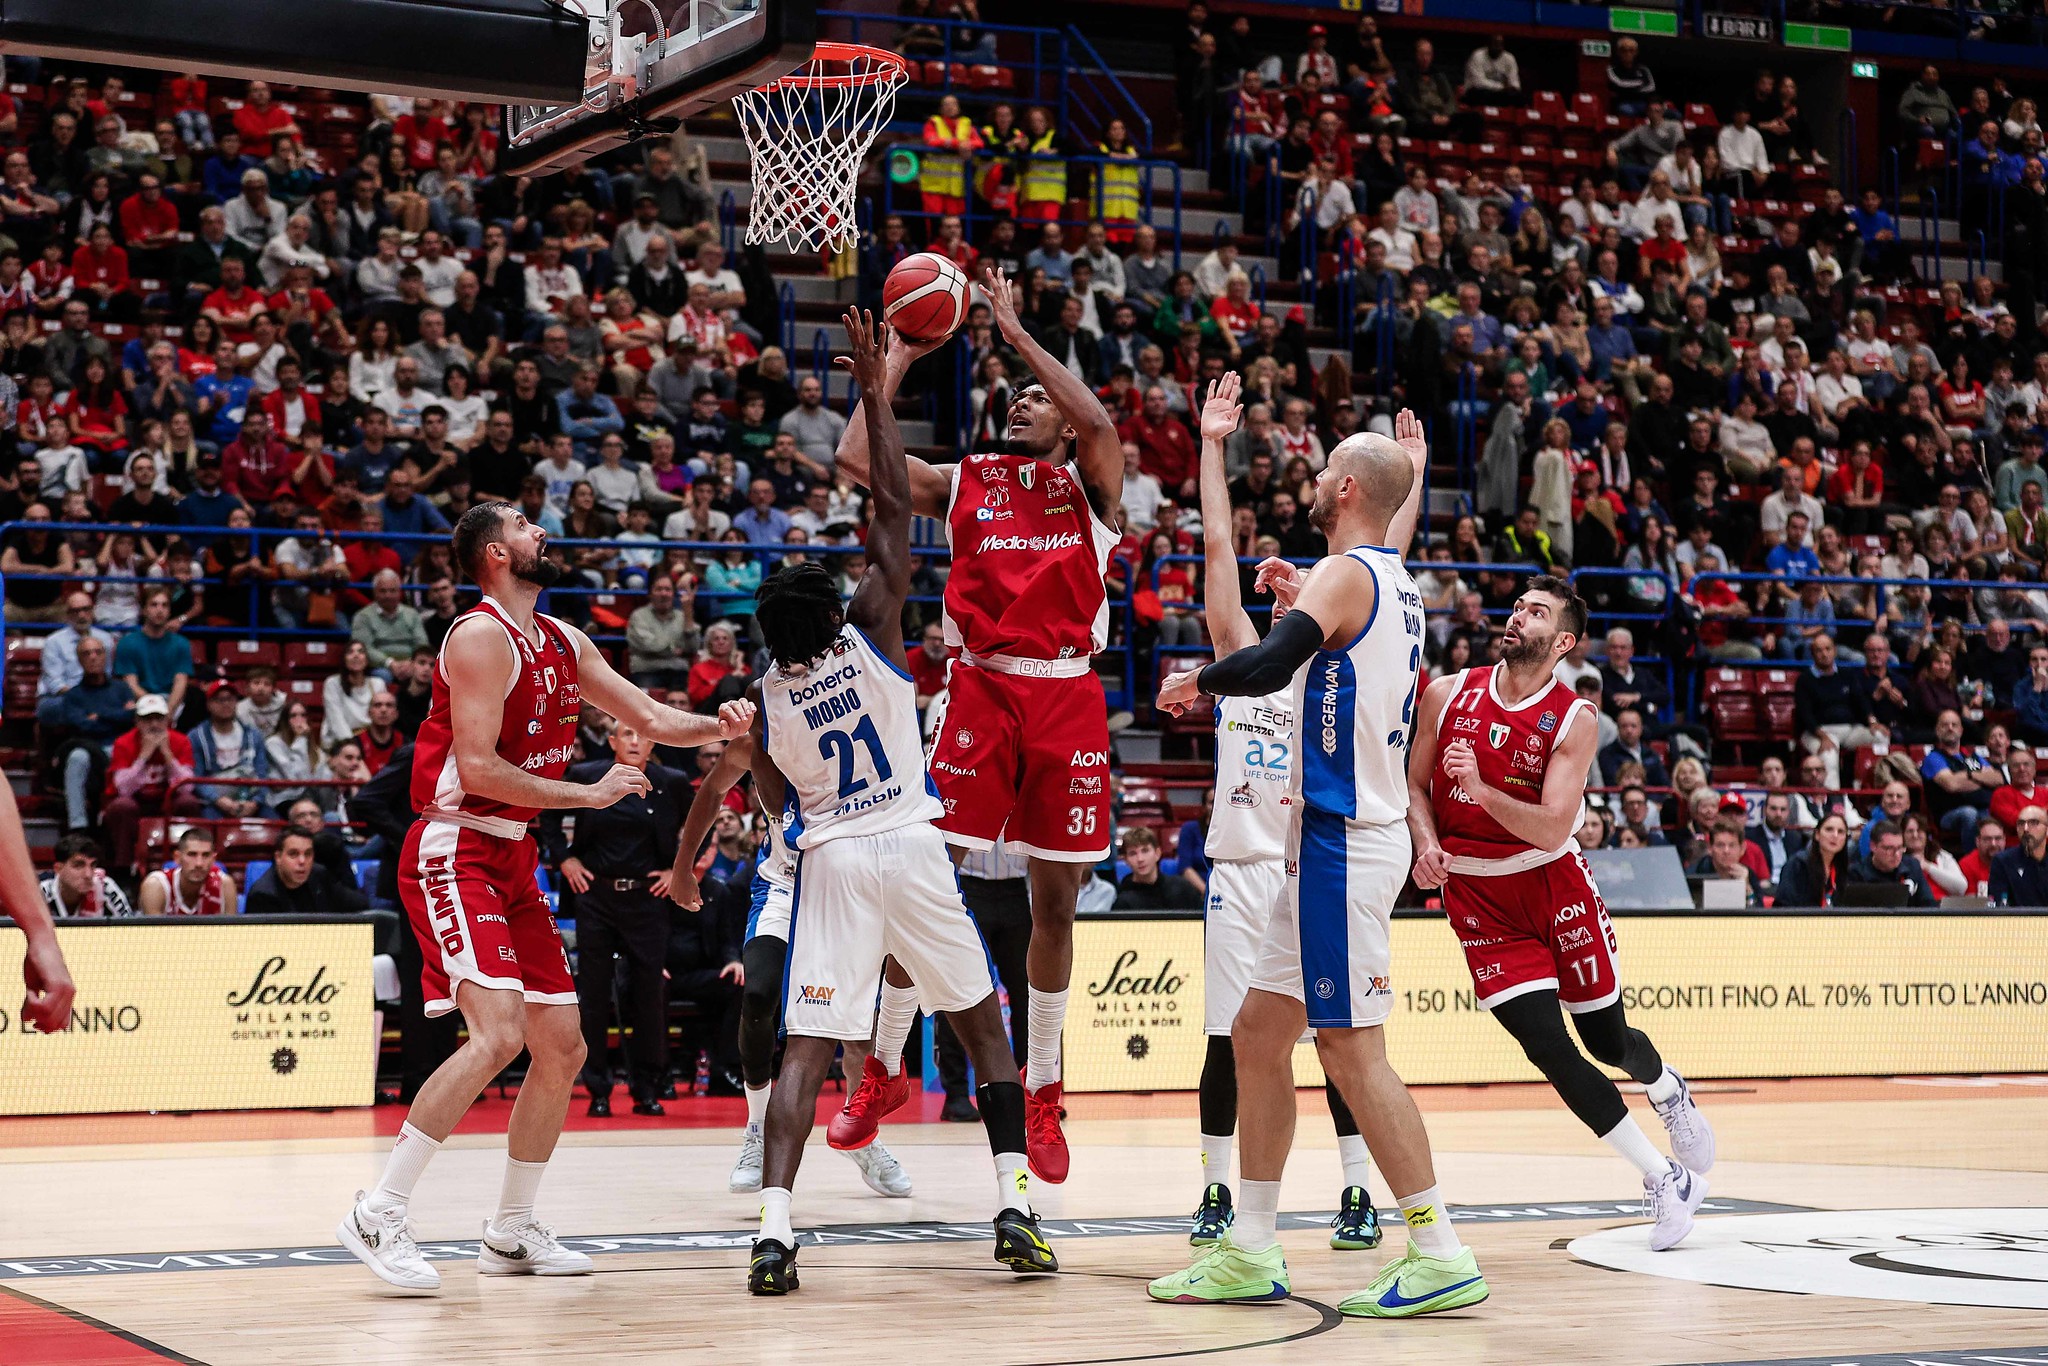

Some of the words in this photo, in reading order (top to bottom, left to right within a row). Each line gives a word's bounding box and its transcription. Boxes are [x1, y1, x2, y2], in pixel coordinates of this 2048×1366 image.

[981, 467, 1008, 479] EA7
[977, 535, 1027, 554] Media
[1020, 660, 1053, 676] OM
[789, 664, 861, 706] bonera.
[1322, 660, 1340, 728] GERMANI
[803, 687, 861, 731] MOBIO
[1456, 688, 1486, 712] 17
[1455, 717, 1481, 730] EA7
[818, 713, 892, 799] 21
[1071, 750, 1107, 767] AON
[1244, 769, 1261, 779] LIFE
[1067, 806, 1097, 836] 35
[1560, 936, 1594, 953] EYEWEAR
[1088, 950, 1184, 996] Scalo
[1476, 963, 1501, 980] EA7
[1571, 955, 1600, 987] 17
[227, 956, 340, 1007] Scalo
[804, 998, 831, 1006] SERVICE
[1404, 989, 1446, 1013] 150
[1623, 985, 1713, 1010] SCONTI
[1722, 984, 1778, 1008] FINO
[1786, 984, 1815, 1008] AL
[1822, 984, 1872, 1007] 70%
[1880, 983, 1956, 1006] TUTTO
[1963, 982, 2048, 1005] L'ANNO
[1096, 1001, 1177, 1012] MILANO
[237, 1010, 330, 1024] MILANO
[1093, 1018, 1134, 1028] OUTLET
[1411, 1216, 1433, 1226] PRS
